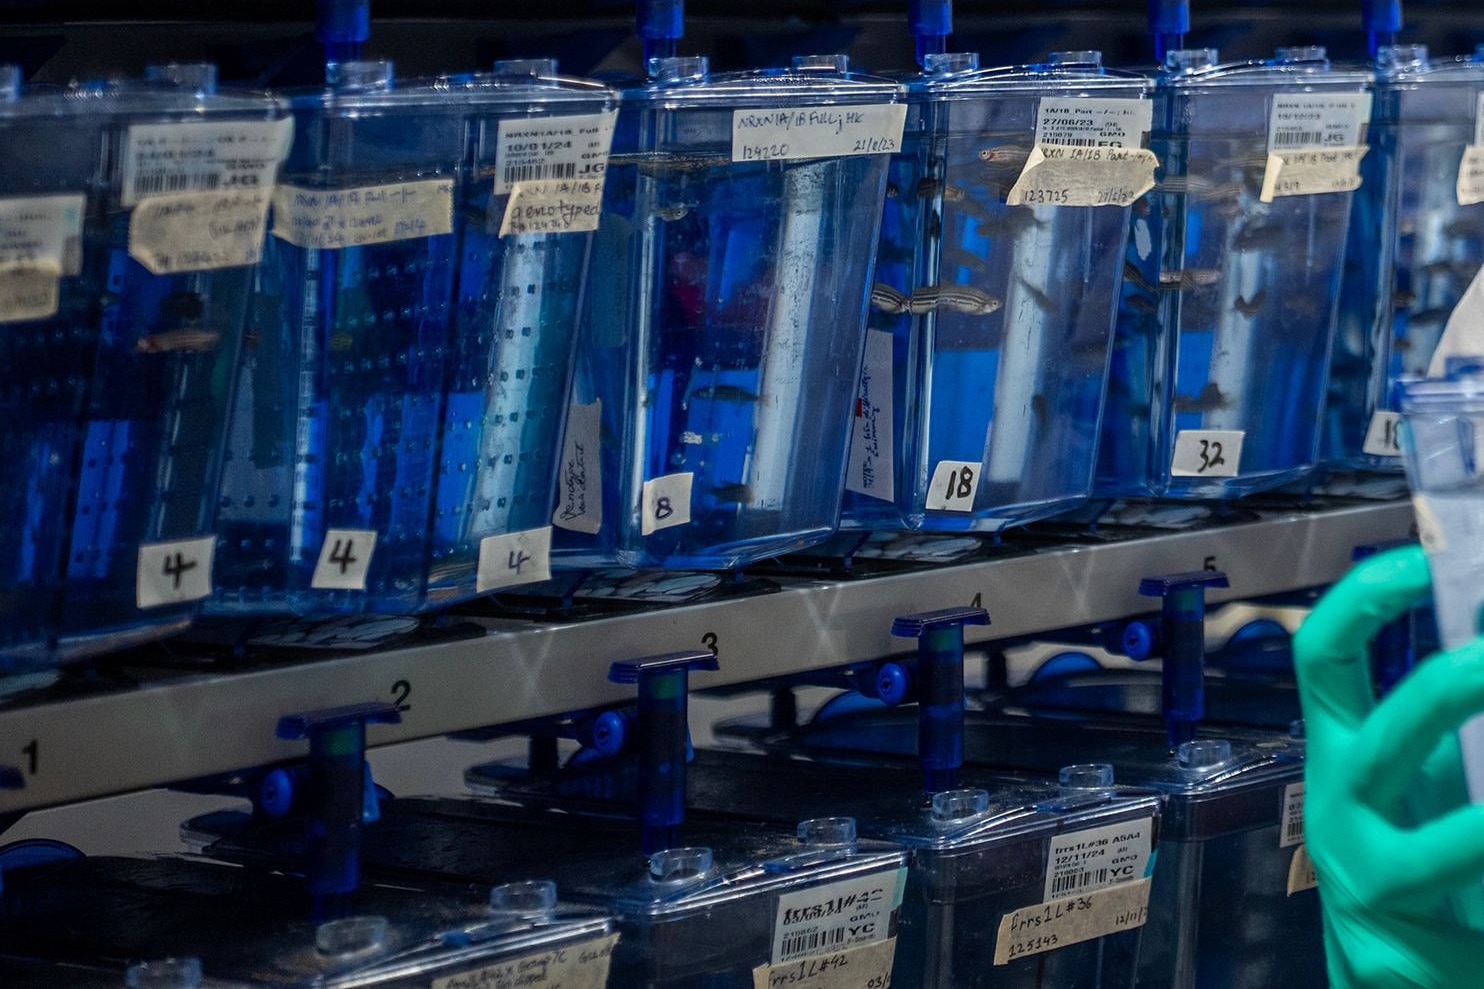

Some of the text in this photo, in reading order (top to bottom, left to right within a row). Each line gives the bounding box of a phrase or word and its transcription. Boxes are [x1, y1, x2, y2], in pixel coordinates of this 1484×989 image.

[1043, 118, 1094, 126] 27/06/23
[743, 144, 790, 160] 124220
[578, 163, 605, 174] JG
[1024, 189, 1069, 203] 123725
[1197, 439, 1224, 473] 32
[945, 466, 973, 500] 18
[655, 497, 673, 519] 8
[328, 539, 357, 573] 4
[508, 550, 529, 574] 4
[162, 552, 196, 589] 4
[701, 632, 718, 656] 3
[391, 680, 411, 710] 2
[22, 740, 38, 774] 1
[1055, 849, 1105, 864] 12/11/24
[1110, 865, 1134, 877] YC
[848, 923, 875, 936] YC
[1009, 934, 1058, 957] 125143
